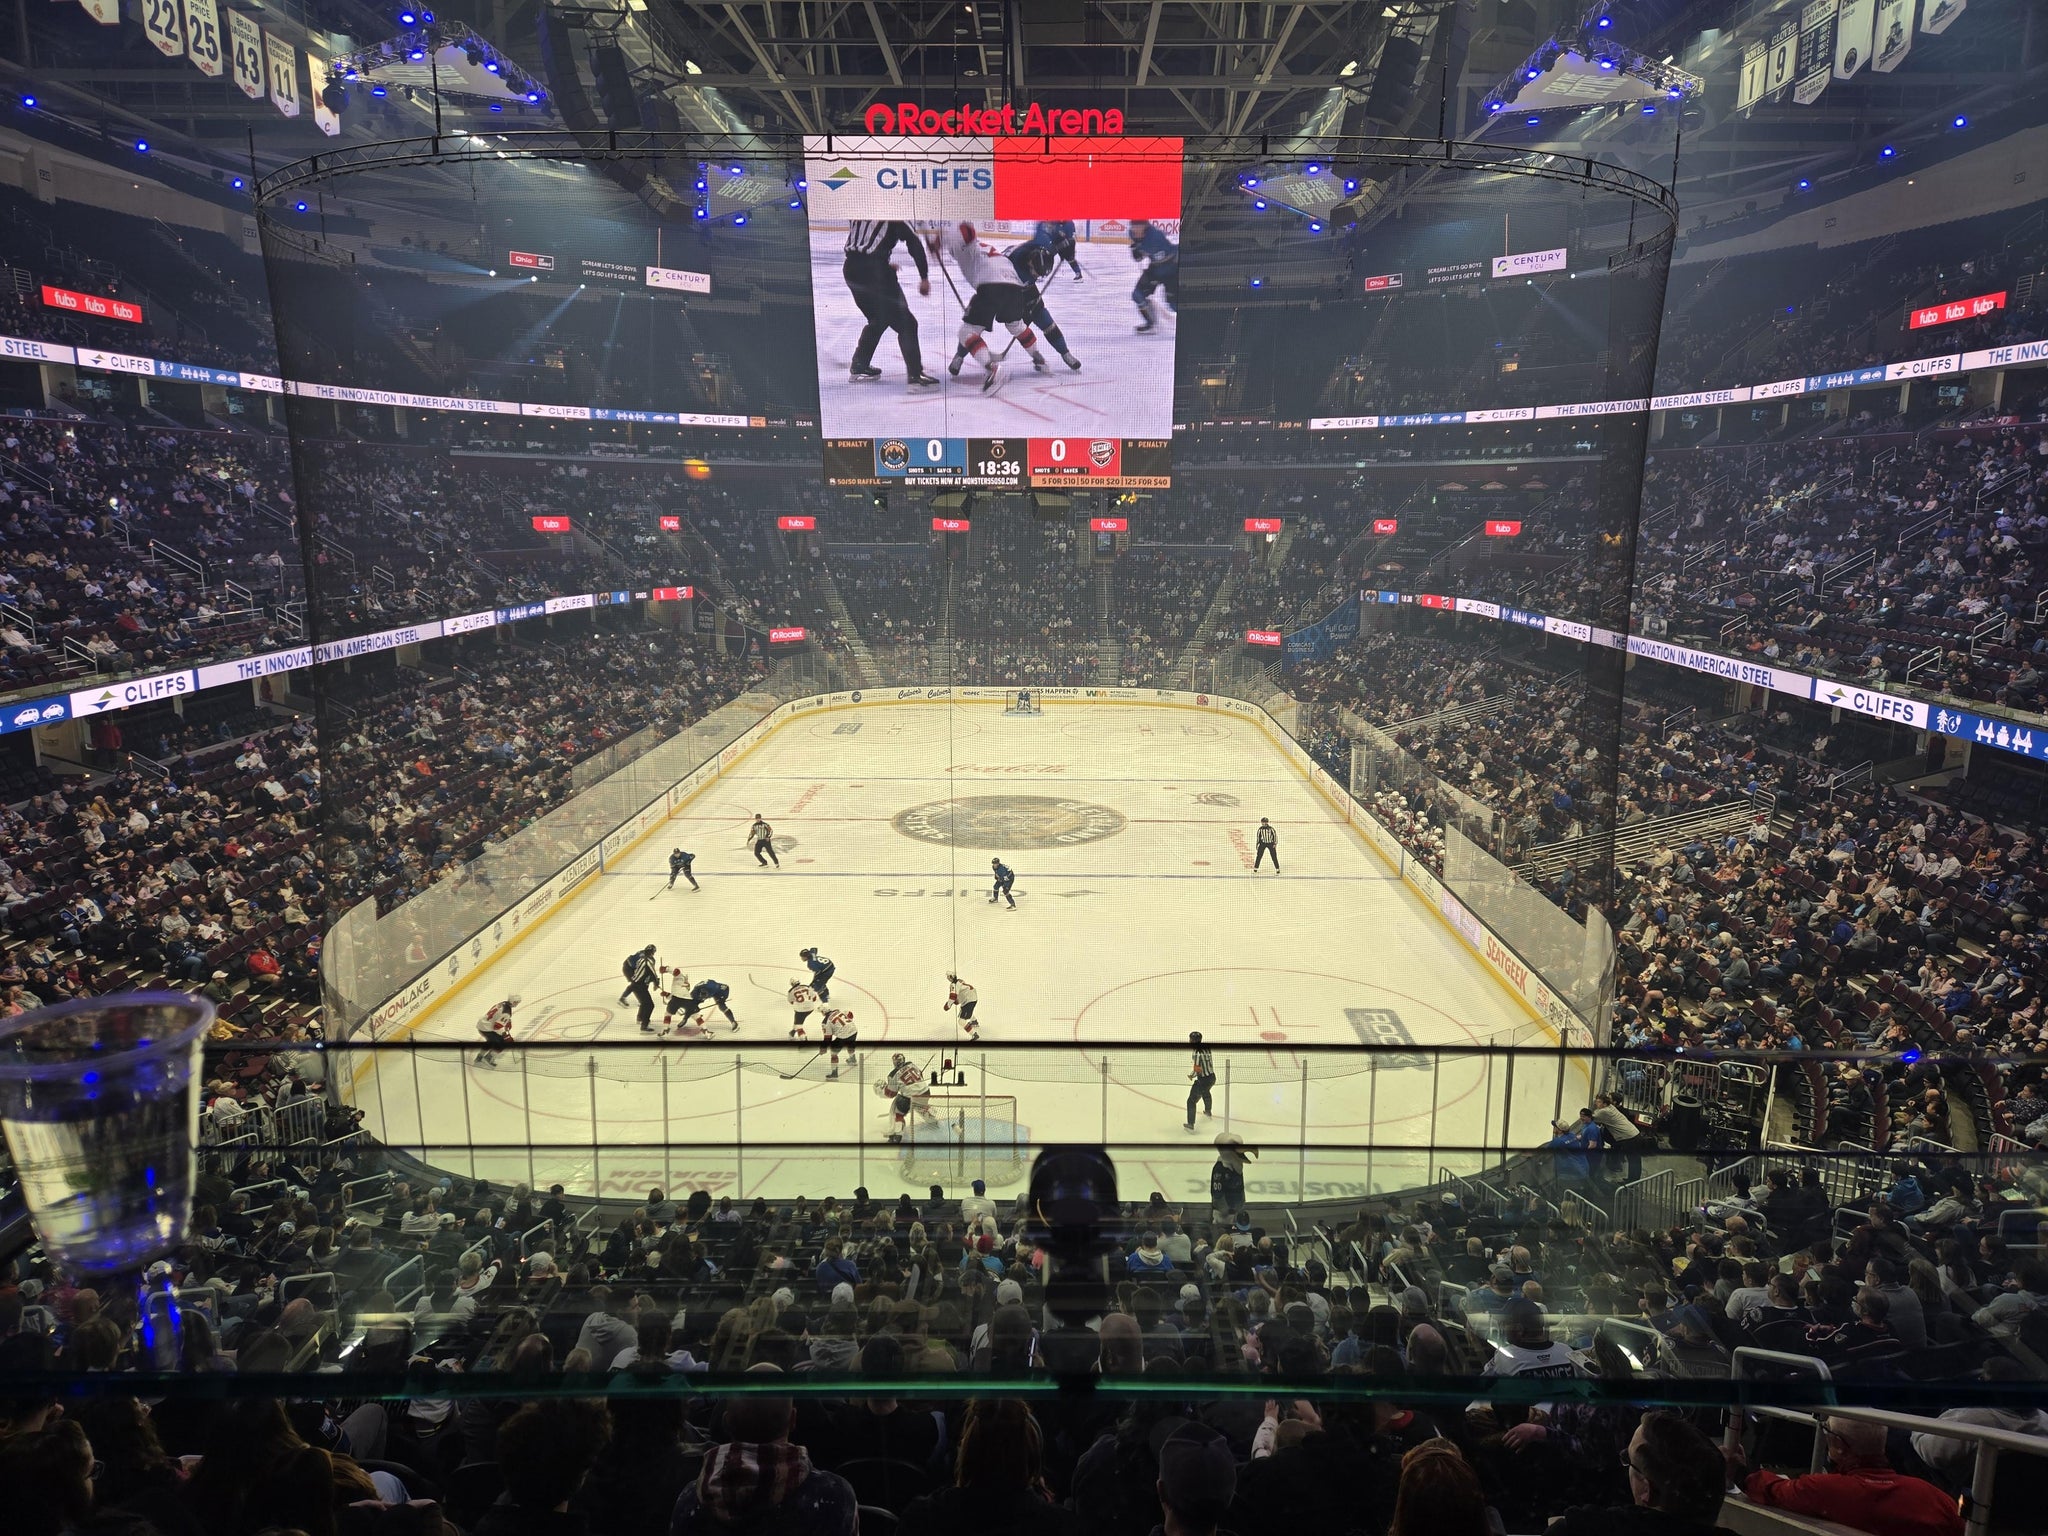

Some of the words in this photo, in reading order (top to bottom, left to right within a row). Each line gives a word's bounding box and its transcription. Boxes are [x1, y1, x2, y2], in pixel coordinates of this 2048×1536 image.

[191, 3, 211, 19] PRICE
[1807, 4, 1832, 25] BARONS
[190, 14, 218, 62] 25
[1772, 22, 1798, 45] GLOVER
[1744, 42, 1766, 63] BOWER
[236, 41, 260, 85] 43
[1776, 46, 1786, 83] 9
[274, 63, 294, 103] 11
[1749, 63, 1756, 100] 1
[899, 103, 1016, 134] Rocket
[1023, 103, 1124, 134] Arena
[876, 167, 992, 191] CLIFFS
[516, 256, 532, 264] Ohio
[1514, 252, 1561, 265] CENTURY
[665, 272, 706, 283] CENTURY
[54, 291, 77, 308] fubo
[85, 297, 106, 314] fubo
[113, 303, 133, 319] fubo
[1919, 311, 1938, 325] fubo
[1946, 305, 1965, 318] fubo
[1973, 299, 1994, 315] fubo
[5, 340, 48, 359] STEEL
[1988, 348, 2012, 364] THE
[111, 356, 150, 372] CLIFFS
[1911, 358, 1952, 374] CLIFFS
[1772, 381, 1800, 395] CLIFFS
[316, 386, 334, 398] THE
[338, 389, 397, 404] INNOVATION
[399, 395, 409, 405] IN
[412, 396, 464, 409] AMERICAN
[467, 401, 499, 412] STEEL
[1556, 405, 1576, 415] THE
[1578, 401, 1640, 414] INNOVATION
[1653, 394, 1702, 408] AMERICAN
[1705, 390, 1735, 403] STEEL
[548, 407, 586, 417] CLIFFS
[1492, 409, 1527, 419] CLIFFS
[704, 416, 740, 425] CLIFFS
[1338, 418, 1373, 427] CLIFFS
[927, 440, 943, 461] 0
[1051, 440, 1066, 461] 0
[978, 461, 1020, 475] 18:36
[543, 519, 559, 529] fubo
[788, 519, 804, 528] fubo
[943, 520, 959, 529] fubo
[1101, 520, 1117, 529] fubo
[1255, 520, 1271, 529] fubo
[1495, 524, 1511, 533] fubo
[561, 597, 586, 609] CLIFFS
[619, 592, 625, 602] 0
[1476, 604, 1495, 616] CLIFFS
[463, 615, 489, 629] CLIFFS
[778, 629, 804, 641] Rocket
[1256, 632, 1280, 643] Rocket
[1562, 623, 1587, 639] CLIFFS
[237, 661, 262, 679] THE
[265, 646, 332, 674] INNOVATON
[334, 645, 343, 658] IN
[346, 634, 393, 655] AMERICAN
[395, 629, 420, 644] STEEL
[1612, 634, 1627, 648] THE
[1627, 636, 1676, 662] INNOVATION
[1678, 650, 1686, 663] IN
[1689, 654, 1739, 678] AMERICAN
[1742, 667, 1775, 688] STEEL
[125, 676, 186, 703] CLIFFS
[898, 688, 922, 700] Culver's
[928, 688, 951, 699] Culver's
[1236, 703, 1254, 715] CLIFFS
[1854, 693, 1914, 722] CLIFFS
[1486, 936, 1528, 996] SEATGEEK
[372, 978, 430, 1029] AVONLAKE
[1246, 1181, 1383, 1196] TRUSTED
